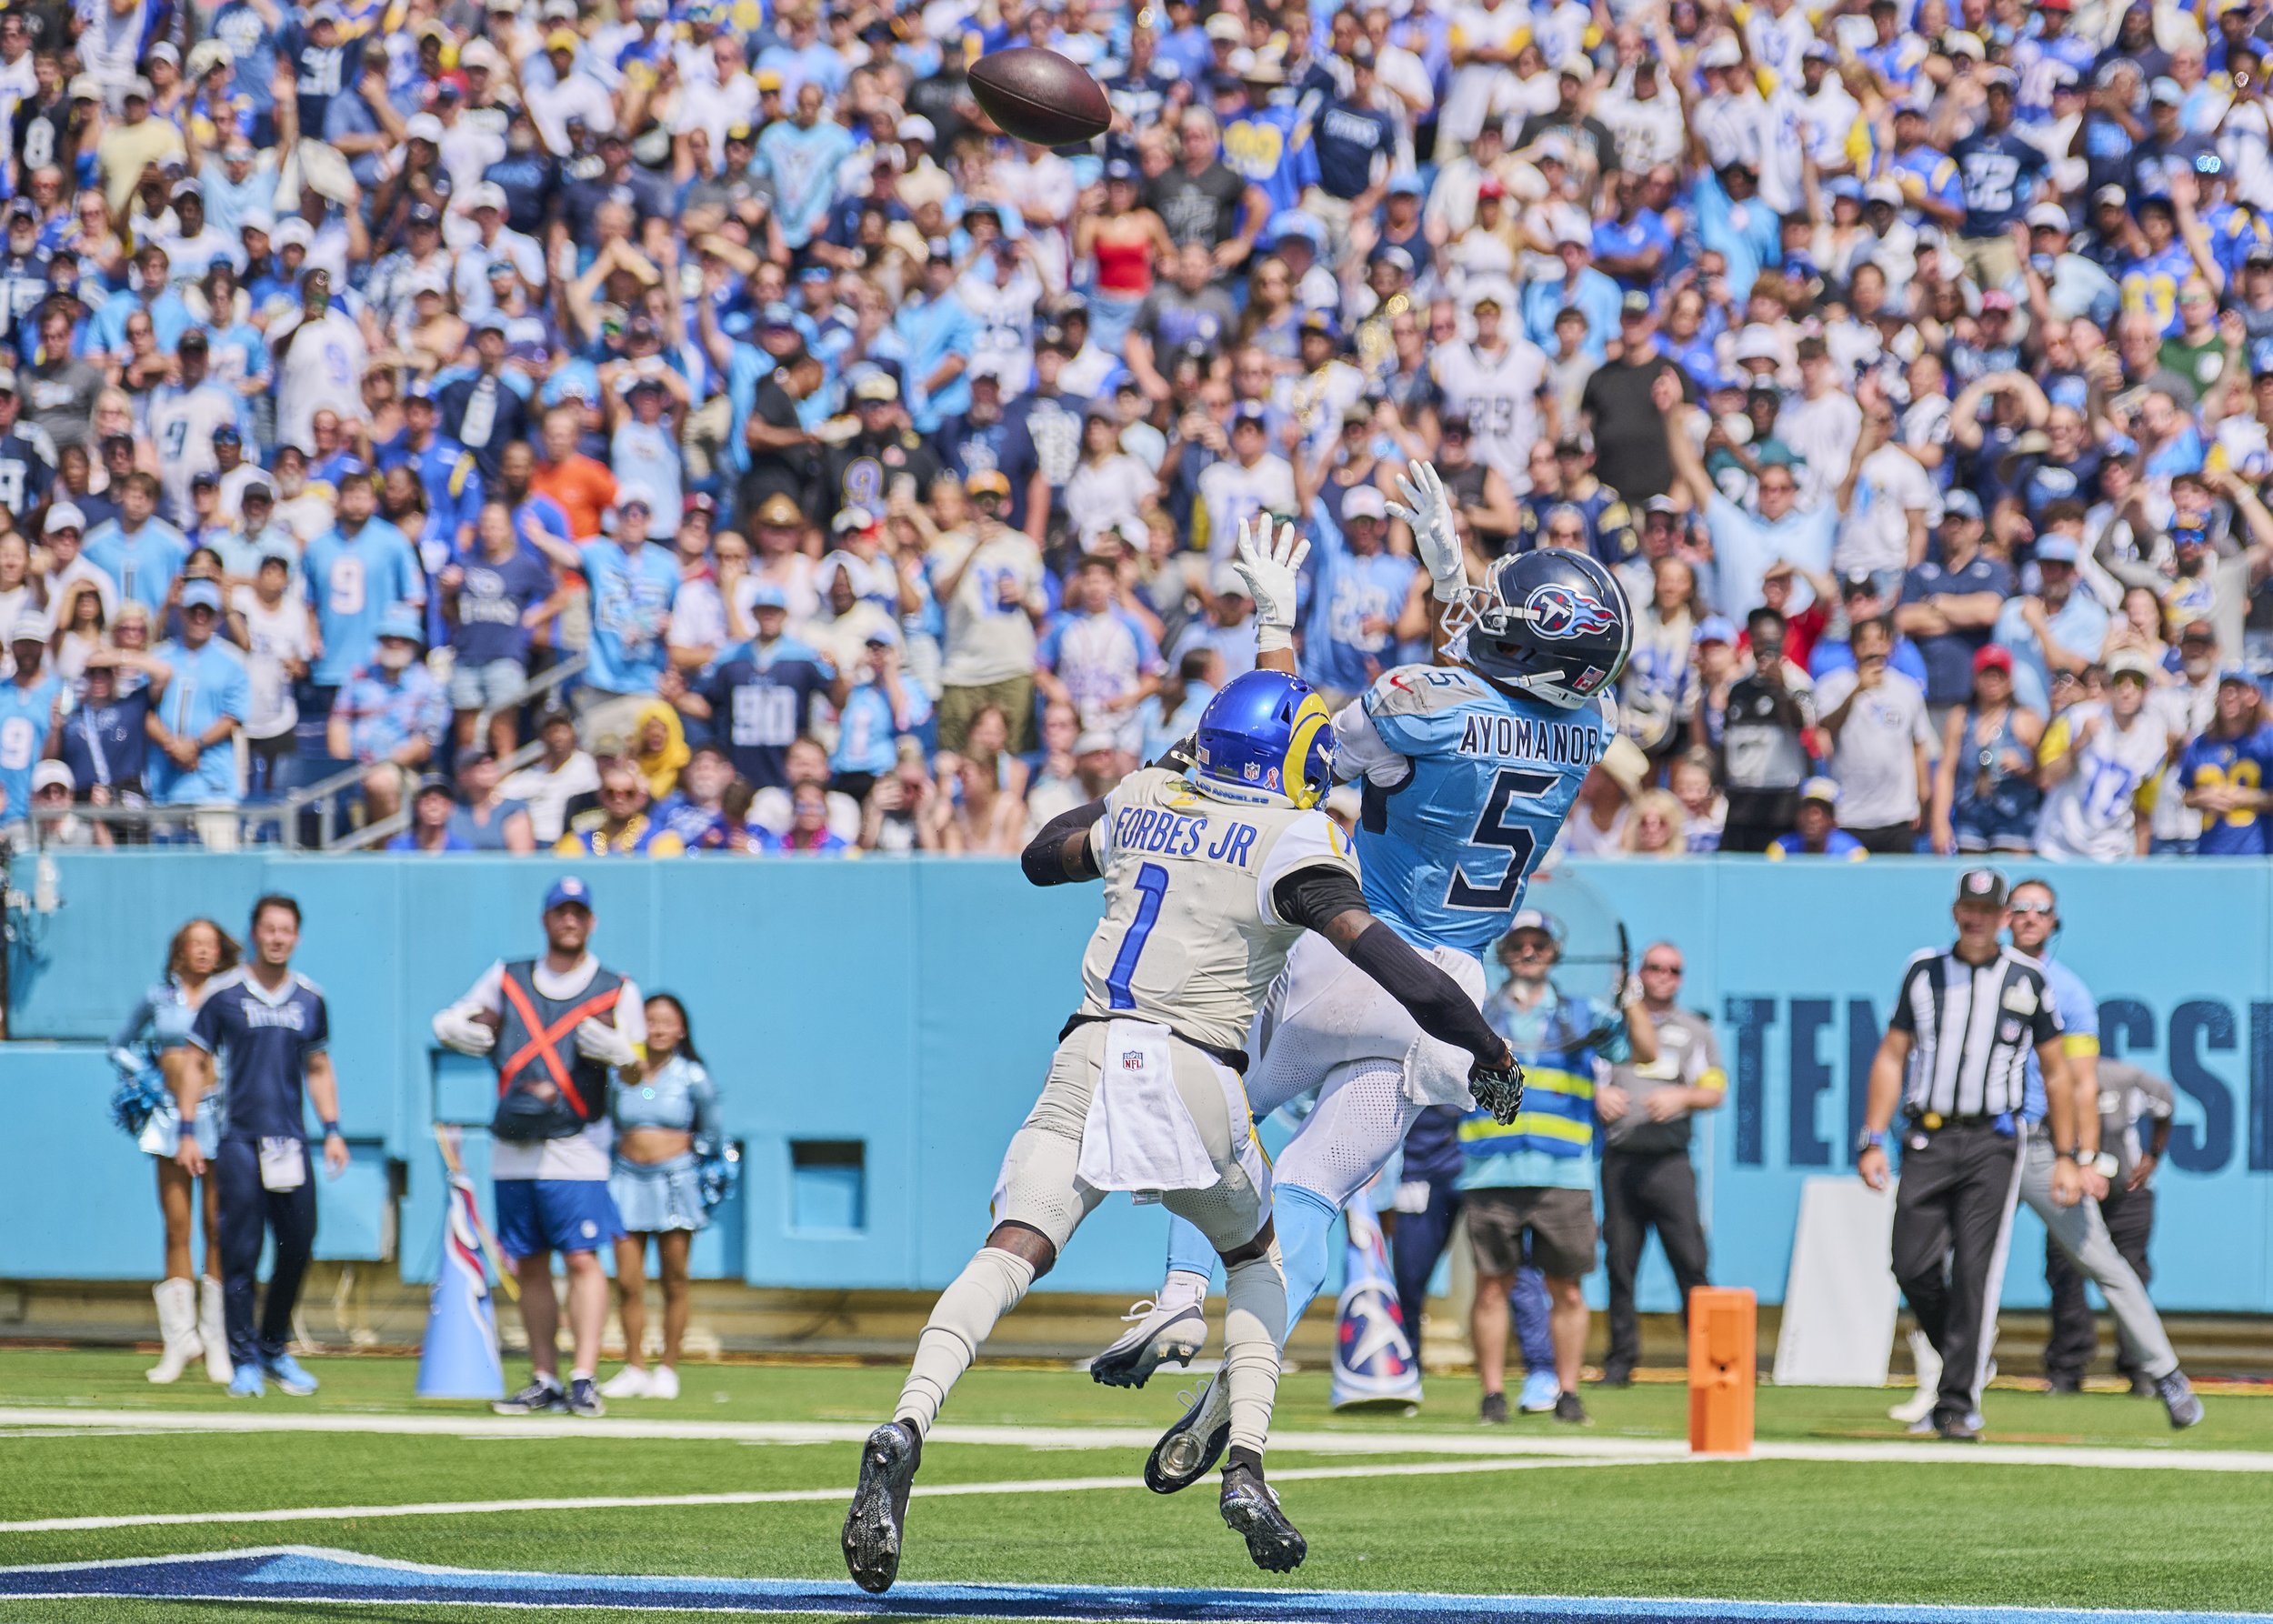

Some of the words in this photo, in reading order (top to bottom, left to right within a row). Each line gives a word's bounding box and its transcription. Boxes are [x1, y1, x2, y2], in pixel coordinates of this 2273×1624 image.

[23, 115, 55, 171] 8
[840, 455, 885, 509] 9
[329, 557, 364, 616] 9
[731, 683, 797, 747] 90
[1457, 712, 1598, 767] AYOMANOR
[0, 717, 35, 771] 9
[1196, 780, 1211, 793] LOS
[1114, 806, 1207, 856] FORBES
[1207, 821, 1257, 867] JR
[1443, 767, 1563, 912] 5
[1106, 860, 1170, 1010] 1
